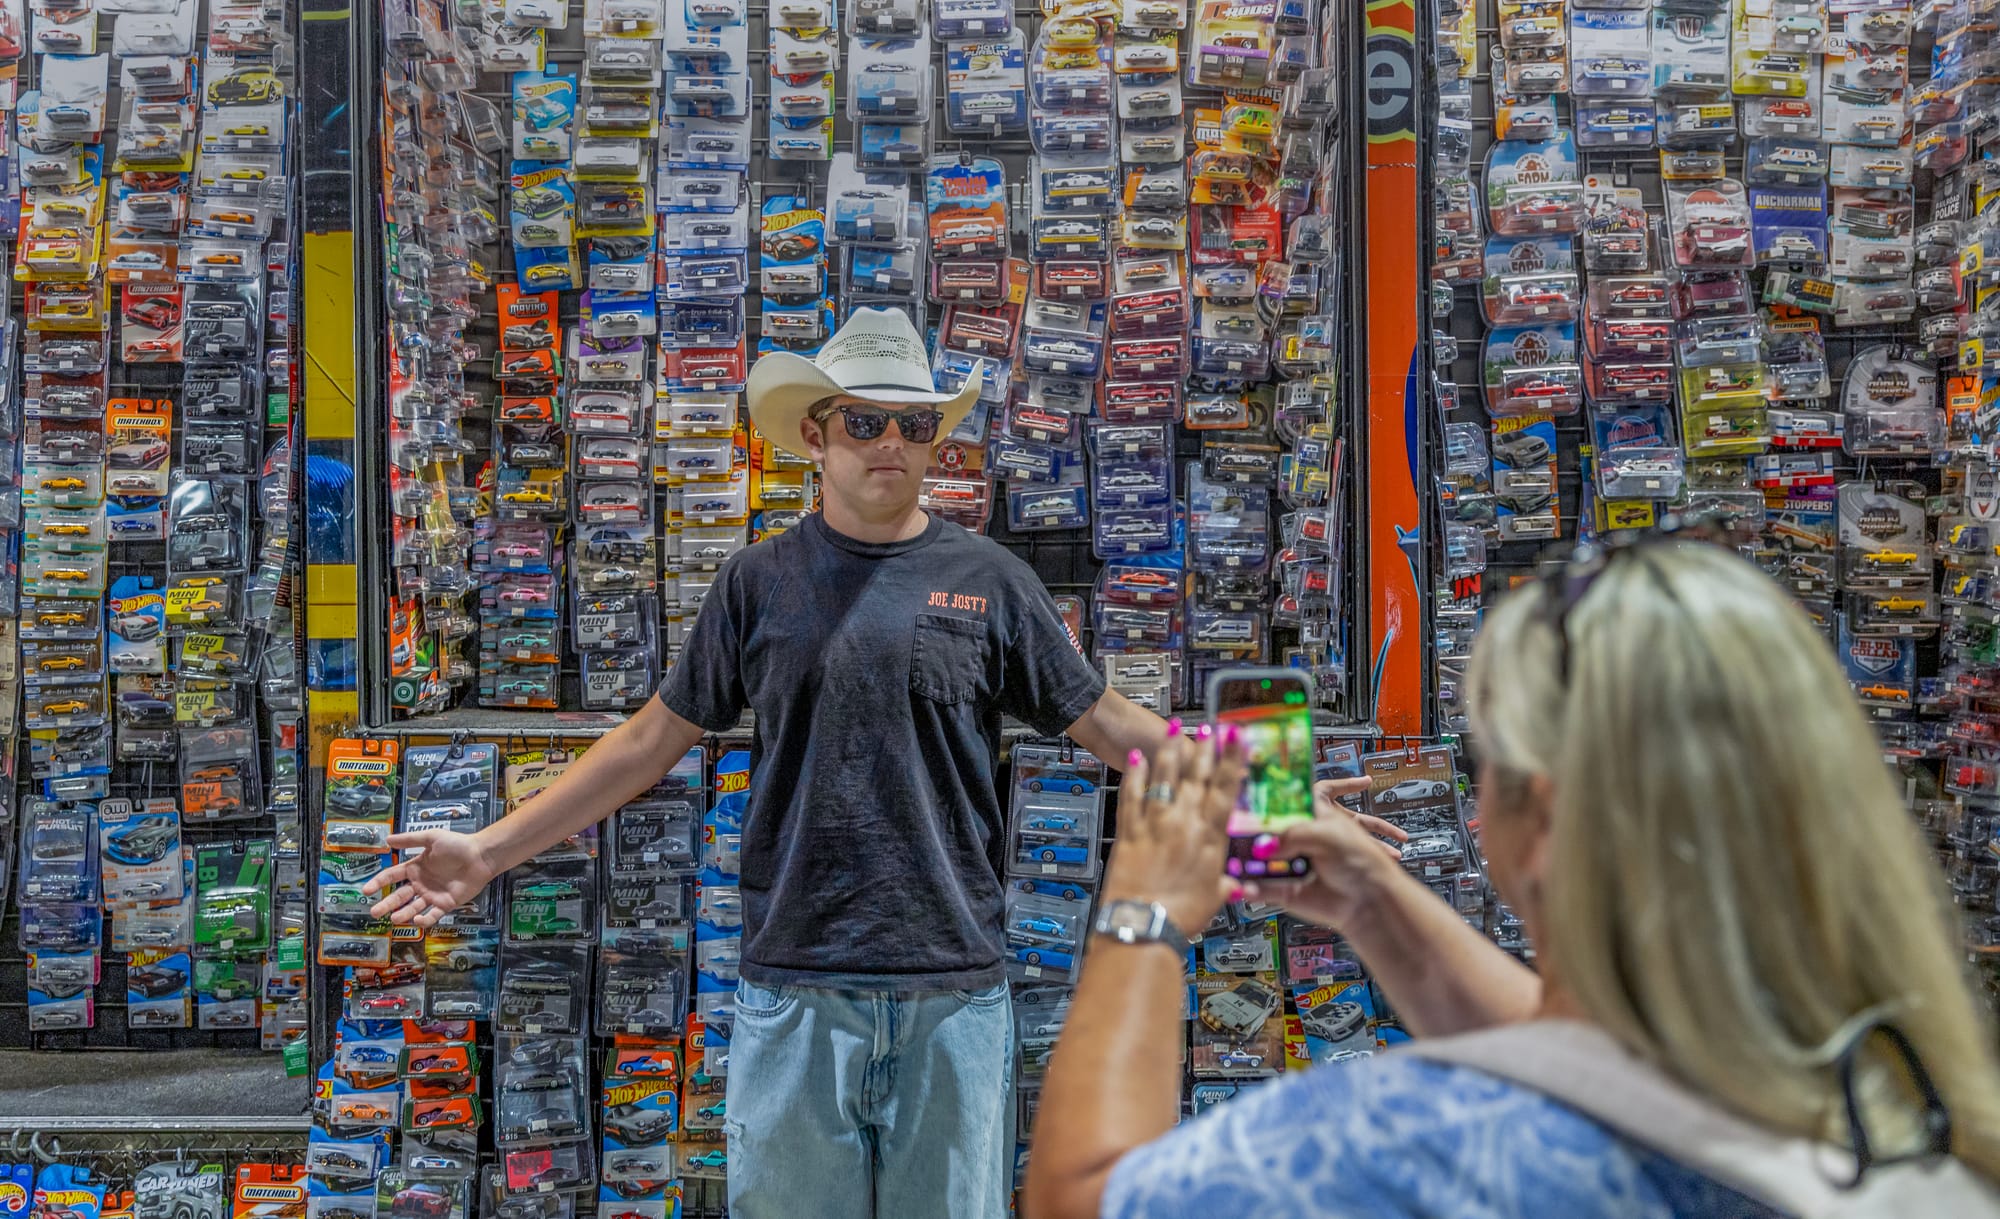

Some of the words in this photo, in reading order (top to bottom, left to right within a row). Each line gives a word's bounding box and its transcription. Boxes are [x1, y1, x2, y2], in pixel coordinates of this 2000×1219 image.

[945, 185, 988, 197] LOUISE
[1755, 194, 1822, 208] ANCHORMAN
[1935, 203, 1960, 220] POLICE
[768, 213, 788, 230] HOT
[1515, 349, 1549, 365] FARM
[185, 382, 215, 390] MINI
[116, 417, 163, 426] MATCHBOX
[1784, 500, 1833, 512] STOPPERS!
[171, 534, 203, 544] MINI
[168, 590, 200, 599] MINI
[121, 598, 137, 612] HOT
[136, 594, 164, 610] WHEELS
[170, 598, 198, 606] GT
[928, 591, 948, 608] JOE
[951, 593, 987, 614] JOST'S
[579, 616, 610, 626] MINI
[582, 625, 608, 634] GT
[186, 635, 218, 645] MINI
[1859, 639, 1892, 649] BLUE
[189, 644, 214, 653] GT
[1851, 648, 1900, 659] COLLAR
[589, 672, 620, 683] MINI
[592, 682, 618, 691] GT
[177, 694, 209, 704] MINI
[181, 703, 207, 711] GT
[412, 753, 437, 761] MINI
[338, 761, 387, 771] MATCHBOX
[185, 786, 216, 795] MINI
[37, 823, 84, 832] PURSUIT
[621, 826, 658, 836] MINI
[625, 835, 656, 844] GT
[613, 887, 650, 898] MINI
[616, 898, 647, 908] GT
[514, 904, 550, 914] MINI
[517, 913, 549, 923] GT
[1290, 947, 1326, 958] MINI
[502, 996, 540, 1007] MINI
[605, 995, 641, 1006] MINI
[1310, 988, 1330, 1006] HOT
[608, 1087, 635, 1107] HOT
[633, 1079, 675, 1101] WHEELS
[1201, 1090, 1227, 1099] MINI
[1204, 1097, 1223, 1106] GT
[47, 1191, 65, 1206] HOT
[64, 1190, 97, 1205] WHEELS
[244, 1187, 298, 1199] MATCHBOX
